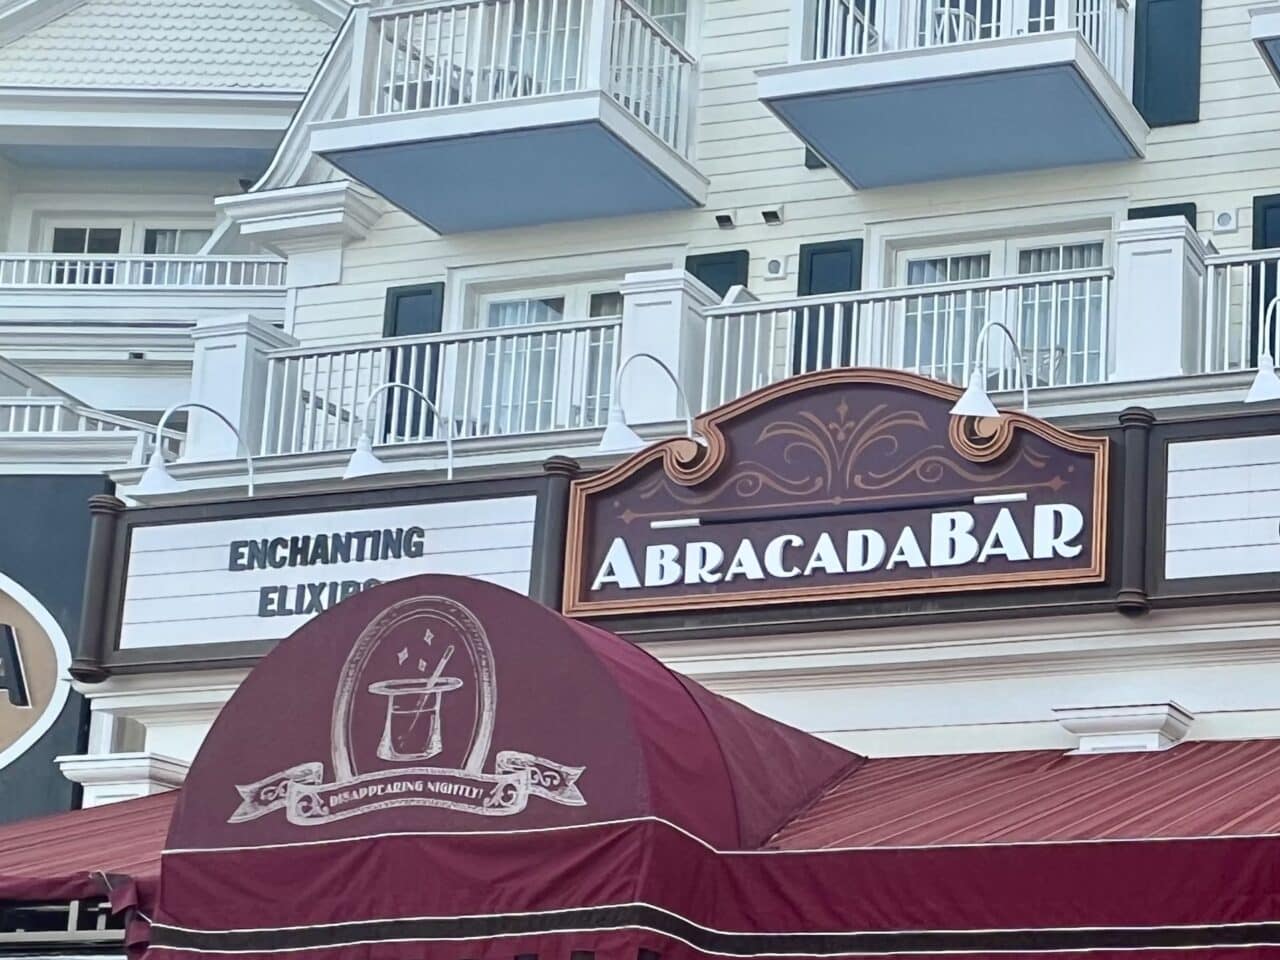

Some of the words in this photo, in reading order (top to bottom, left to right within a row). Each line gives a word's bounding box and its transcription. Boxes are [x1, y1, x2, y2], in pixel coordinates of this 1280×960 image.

[228, 526, 425, 572] ENCHANTING
[590, 502, 1083, 591] ABRACADABAR
[329, 781, 424, 807] DISAPPEARING
